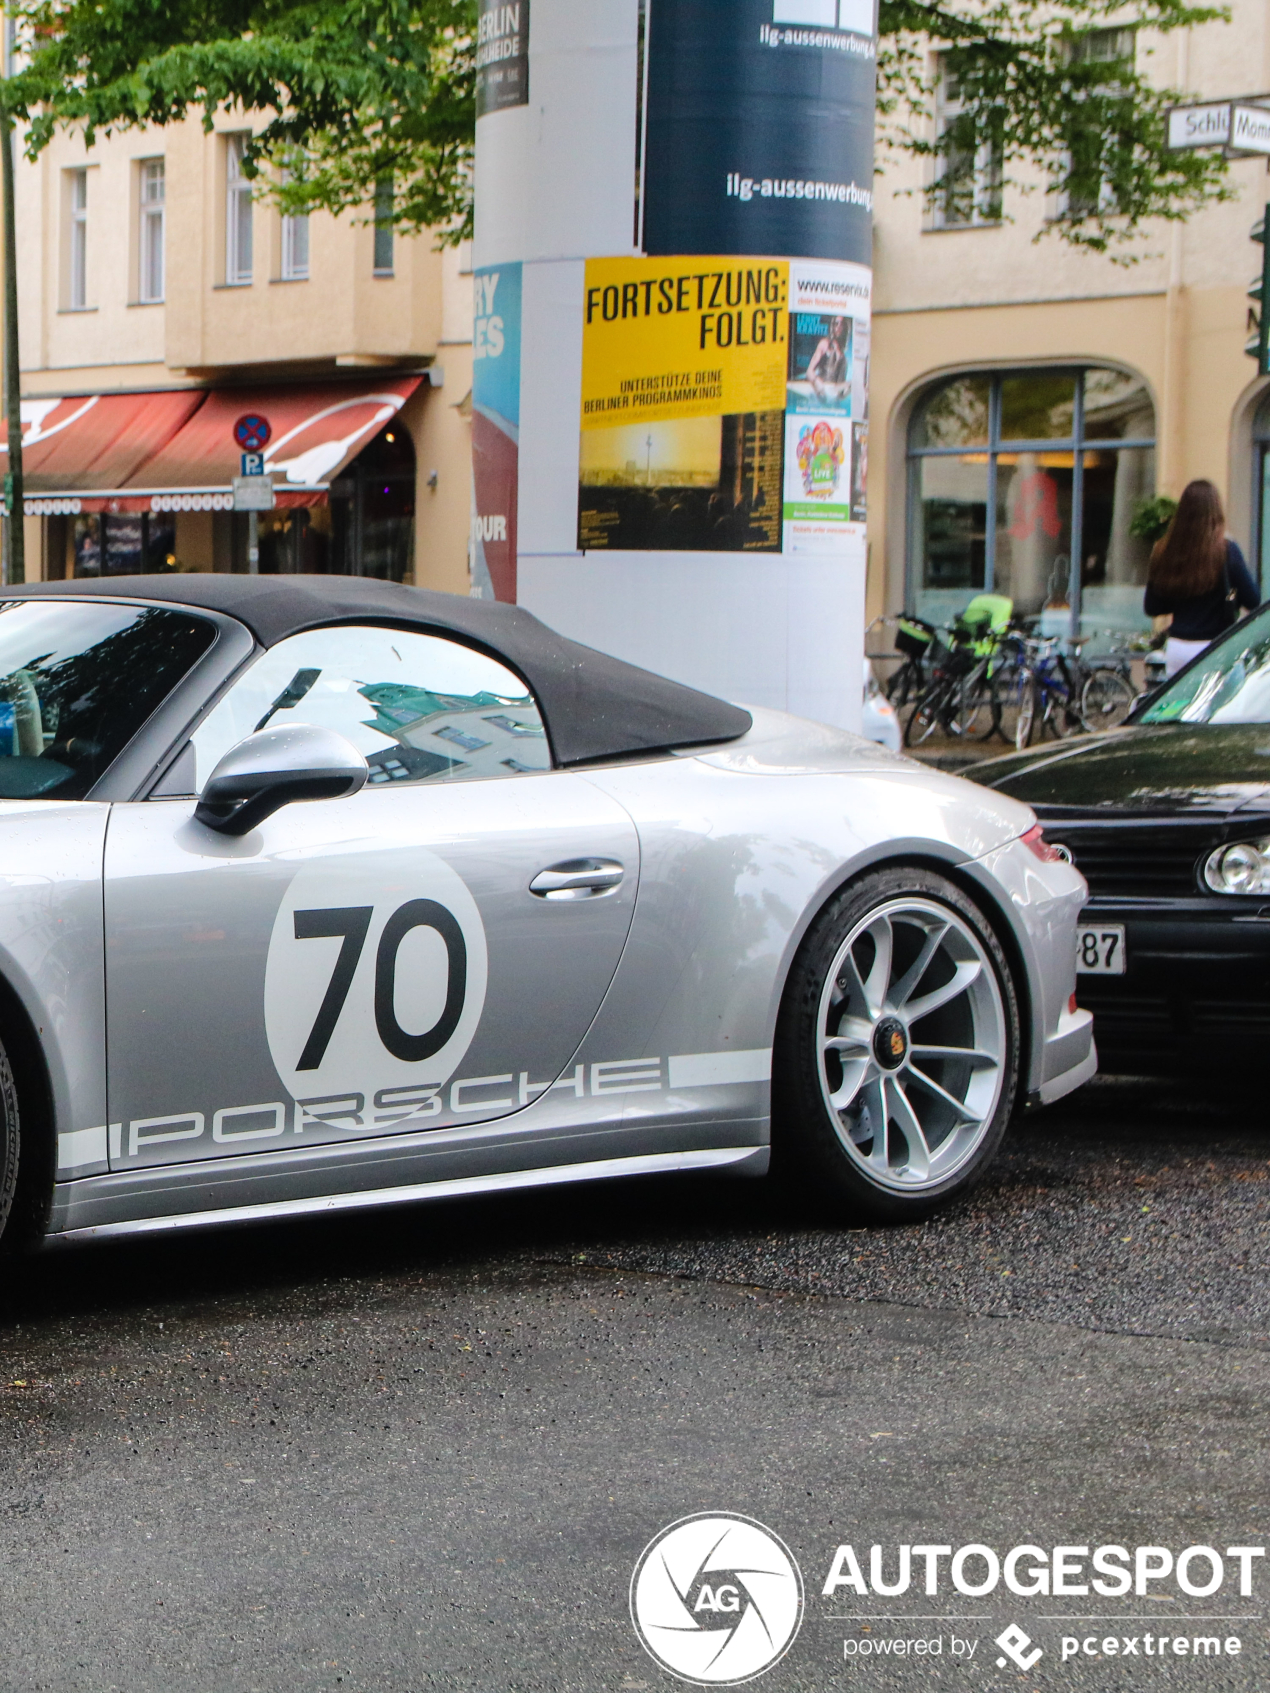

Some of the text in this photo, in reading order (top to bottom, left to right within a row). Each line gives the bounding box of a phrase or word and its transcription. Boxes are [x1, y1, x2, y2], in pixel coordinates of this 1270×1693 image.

[587, 267, 786, 325] FORTSETZUNG:
[699, 307, 785, 350] FOLGT.
[584, 385, 723, 414] BERLINER PROGRAMMKINOS
[620, 369, 723, 394] UNTERSTÜTZE DEINE
[1076, 933, 1119, 967] 87
[293, 898, 467, 1072] 70
[128, 1056, 661, 1156] PORSCHE
[5, 1111, 18, 1192] MICHELIN
